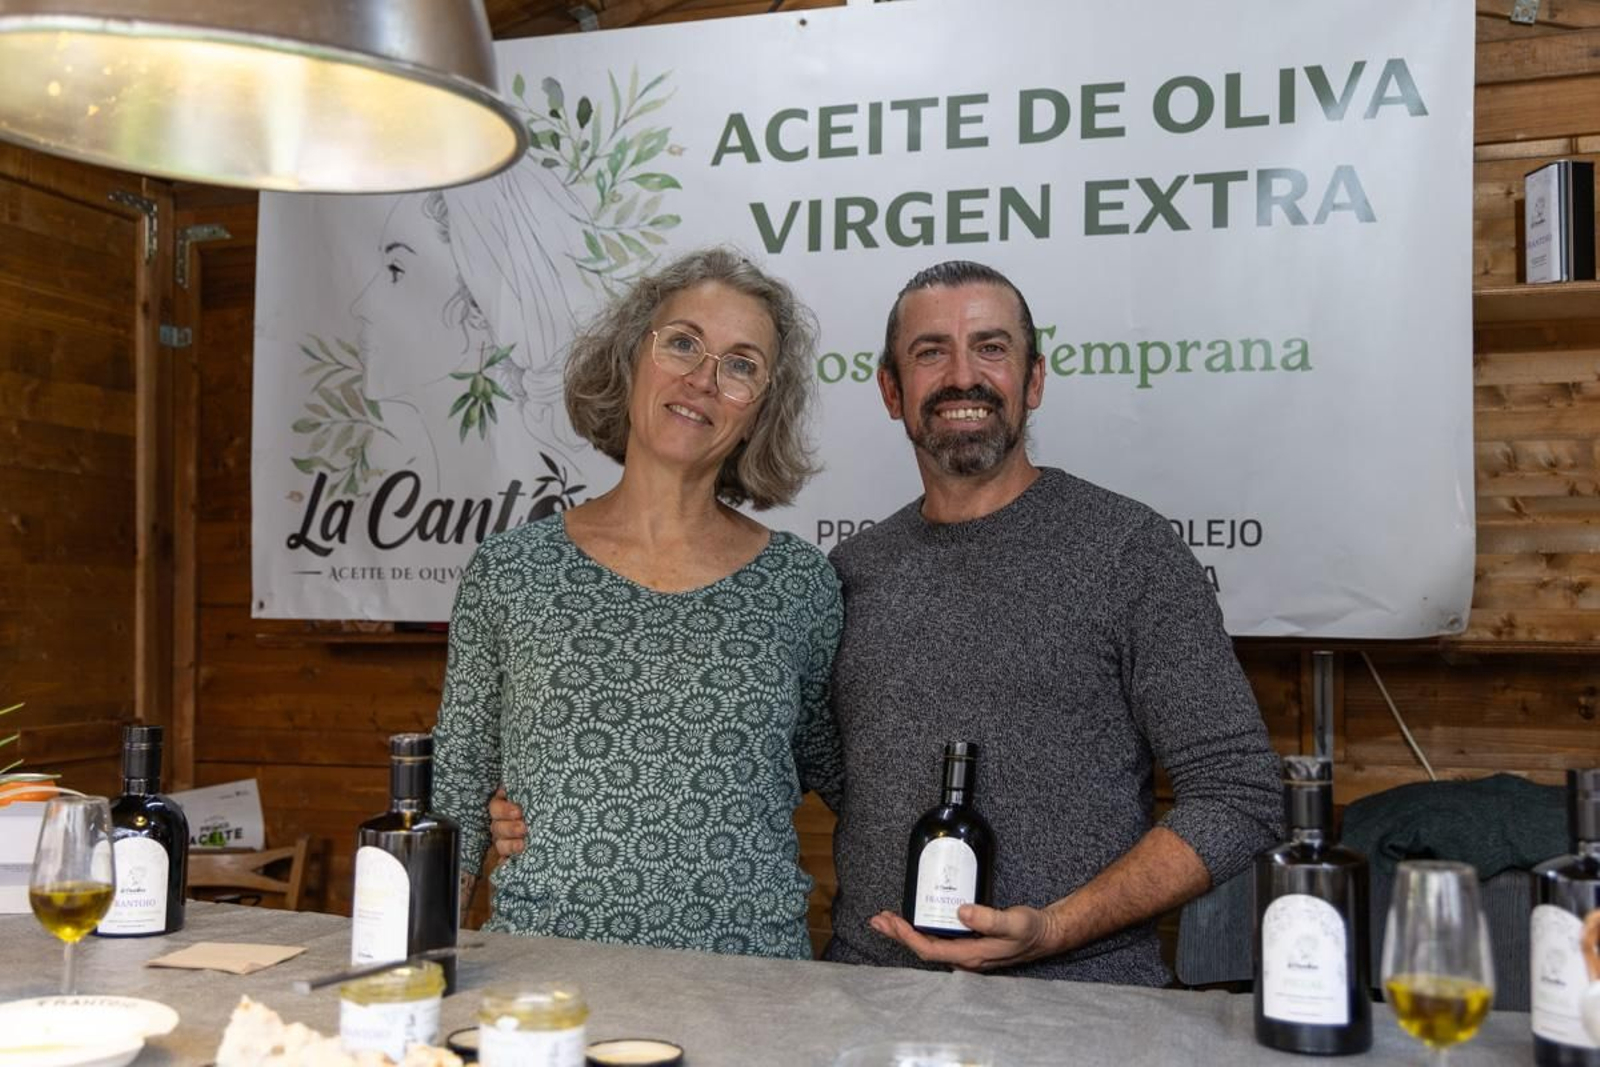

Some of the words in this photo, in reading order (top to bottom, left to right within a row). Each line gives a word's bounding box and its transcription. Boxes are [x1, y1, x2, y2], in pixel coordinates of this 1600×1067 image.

[710, 93, 990, 165] ACEITE
[1018, 82, 1127, 145] DE
[1152, 57, 1428, 134] OLIVA
[749, 184, 1051, 254] VIRGEN
[1083, 165, 1377, 235] EXTRA
[1034, 325, 1313, 389] Temprana
[286, 472, 354, 557] La
[329, 565, 385, 583] ACEITE
[391, 567, 413, 580] DE
